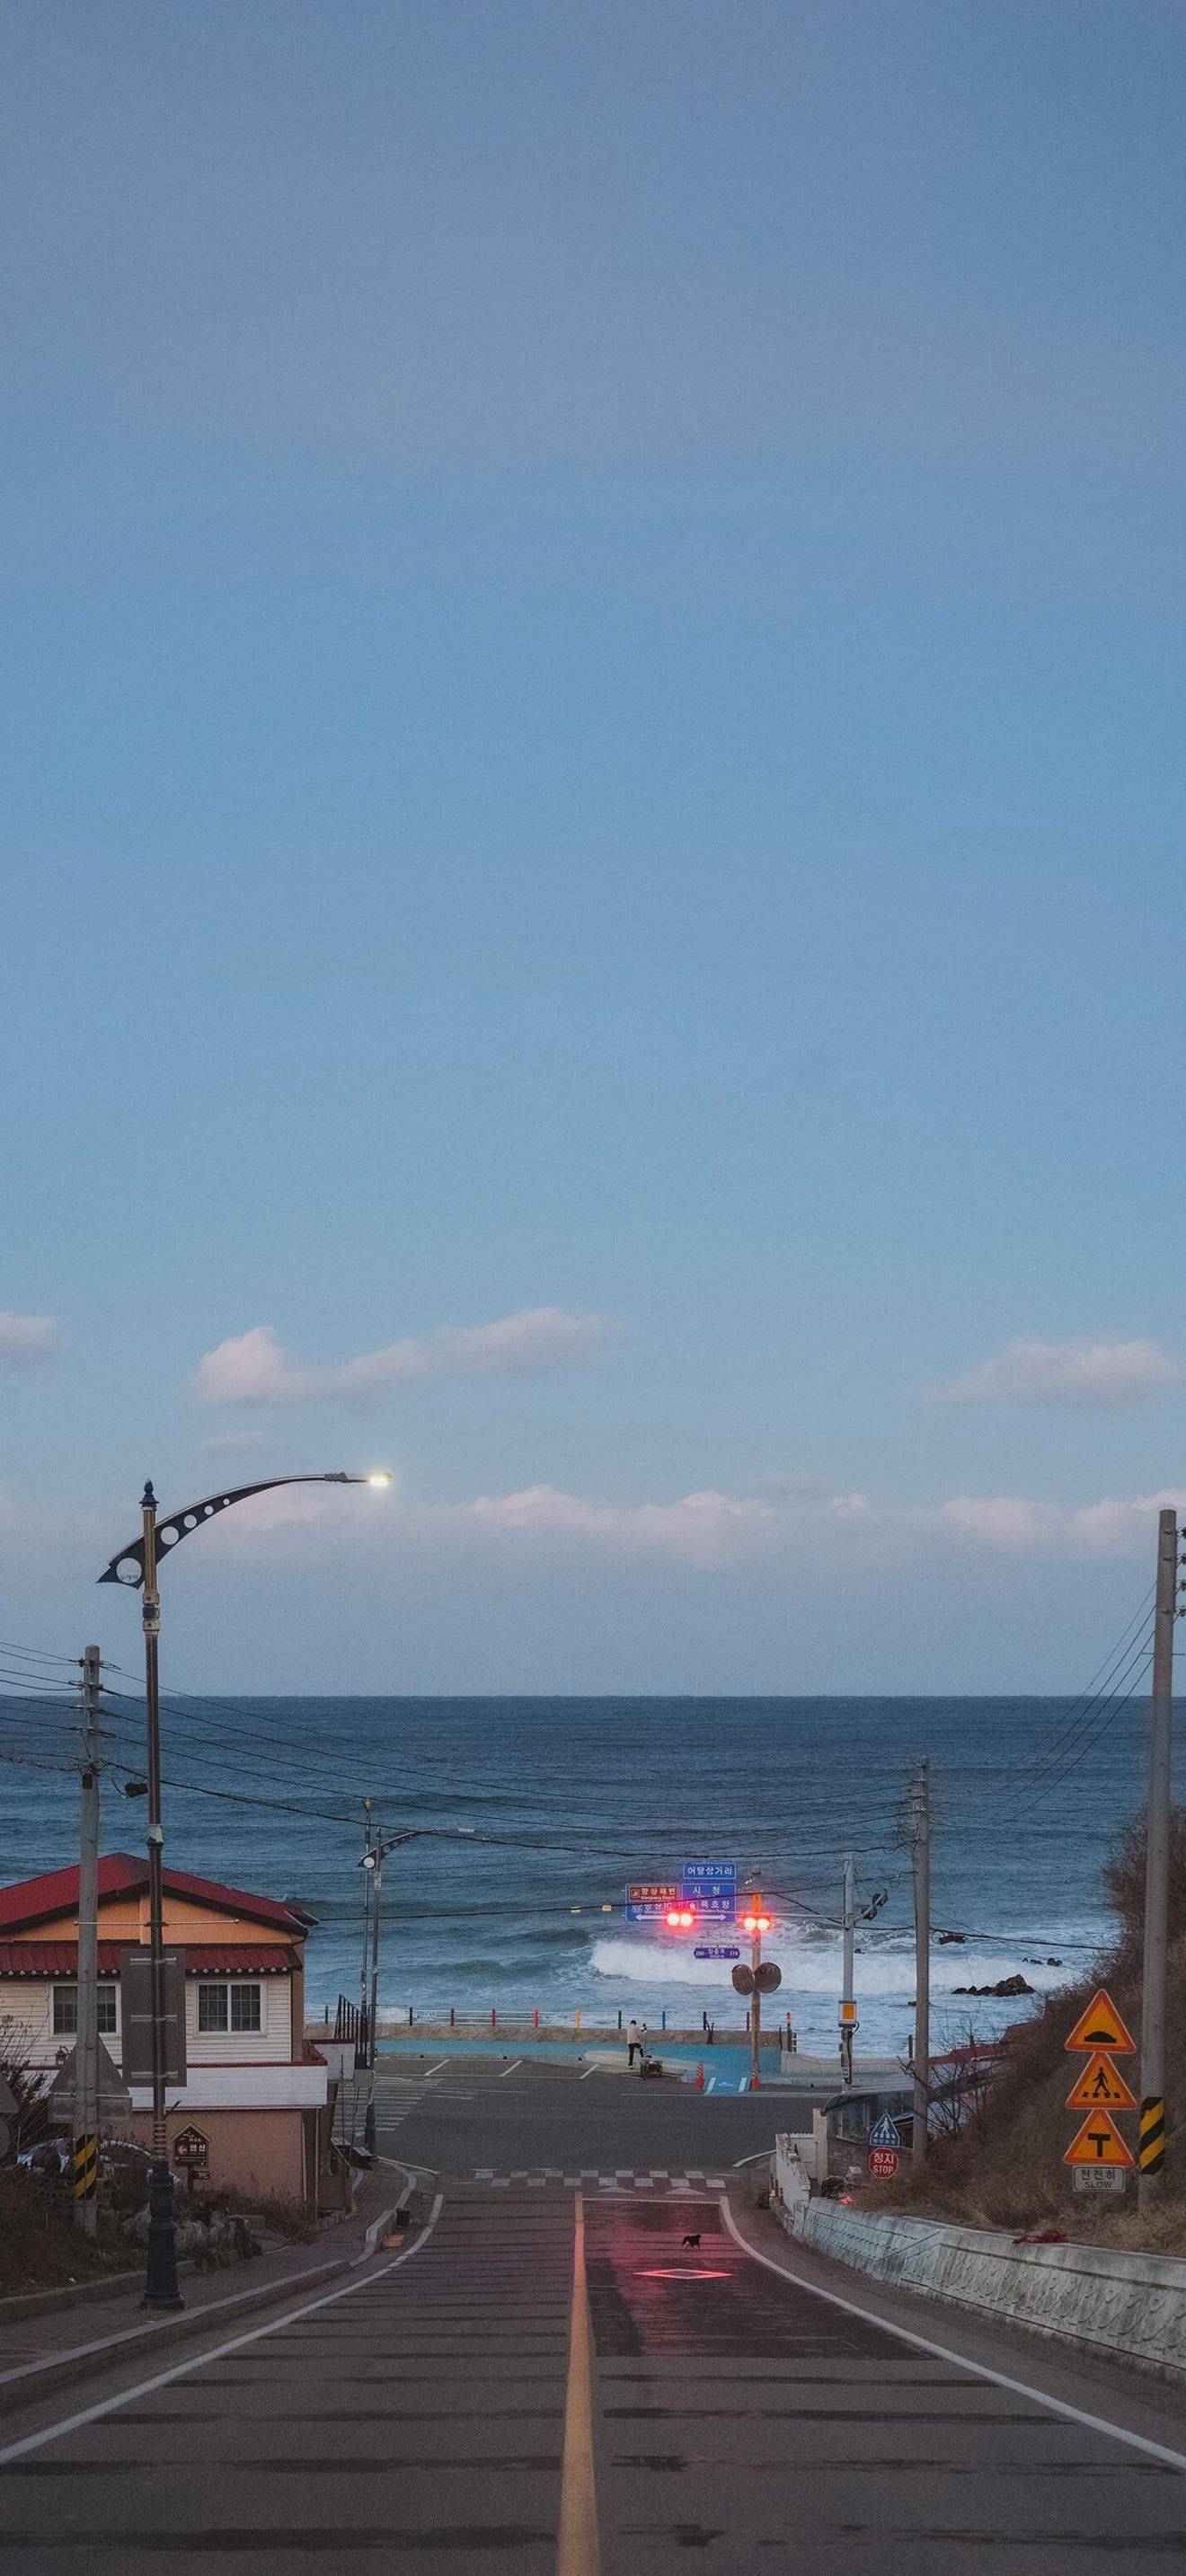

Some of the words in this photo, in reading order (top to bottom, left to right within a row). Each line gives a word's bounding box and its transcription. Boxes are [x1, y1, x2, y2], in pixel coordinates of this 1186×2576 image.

[687, 1866, 732, 1875] 어달삼거리
[874, 2152, 895, 2164] 정지
[873, 2166, 894, 2174] STOP
[1081, 2168, 1115, 2181] 천천히
[1084, 2181, 1112, 2189] SLOW
